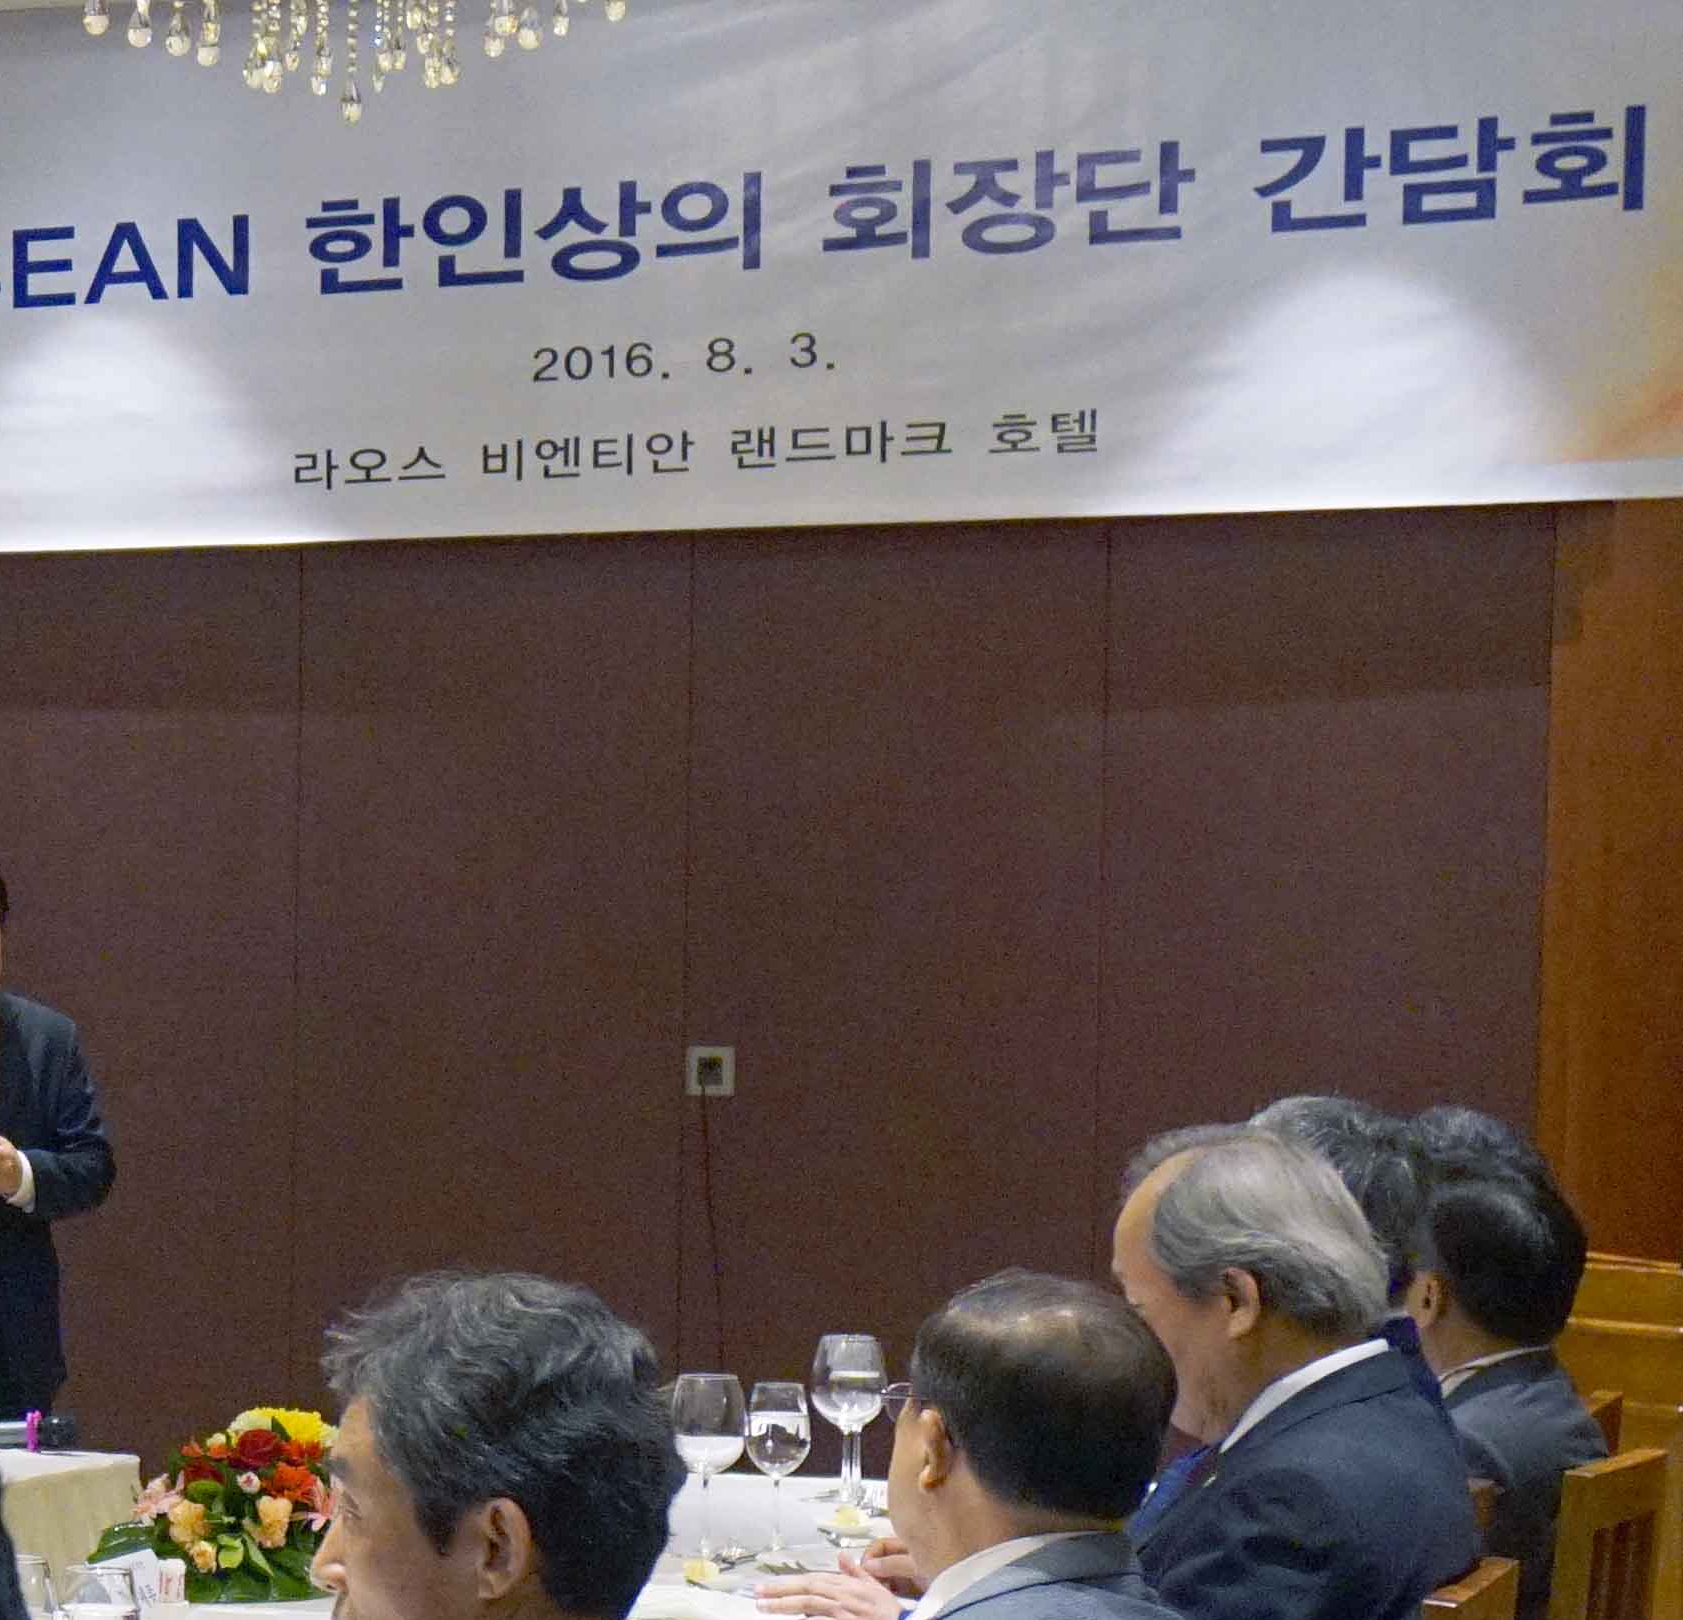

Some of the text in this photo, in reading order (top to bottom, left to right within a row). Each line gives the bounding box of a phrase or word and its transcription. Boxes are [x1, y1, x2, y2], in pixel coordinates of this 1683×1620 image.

[304, 170, 764, 297] 한인상의
[821, 140, 1197, 260] 회장단
[1252, 102, 1648, 234] 간담회
[532, 332, 835, 383] 2016. 8. 3.
[293, 407, 1098, 491] 라오스 비엔티안 랜드마크 호텔
